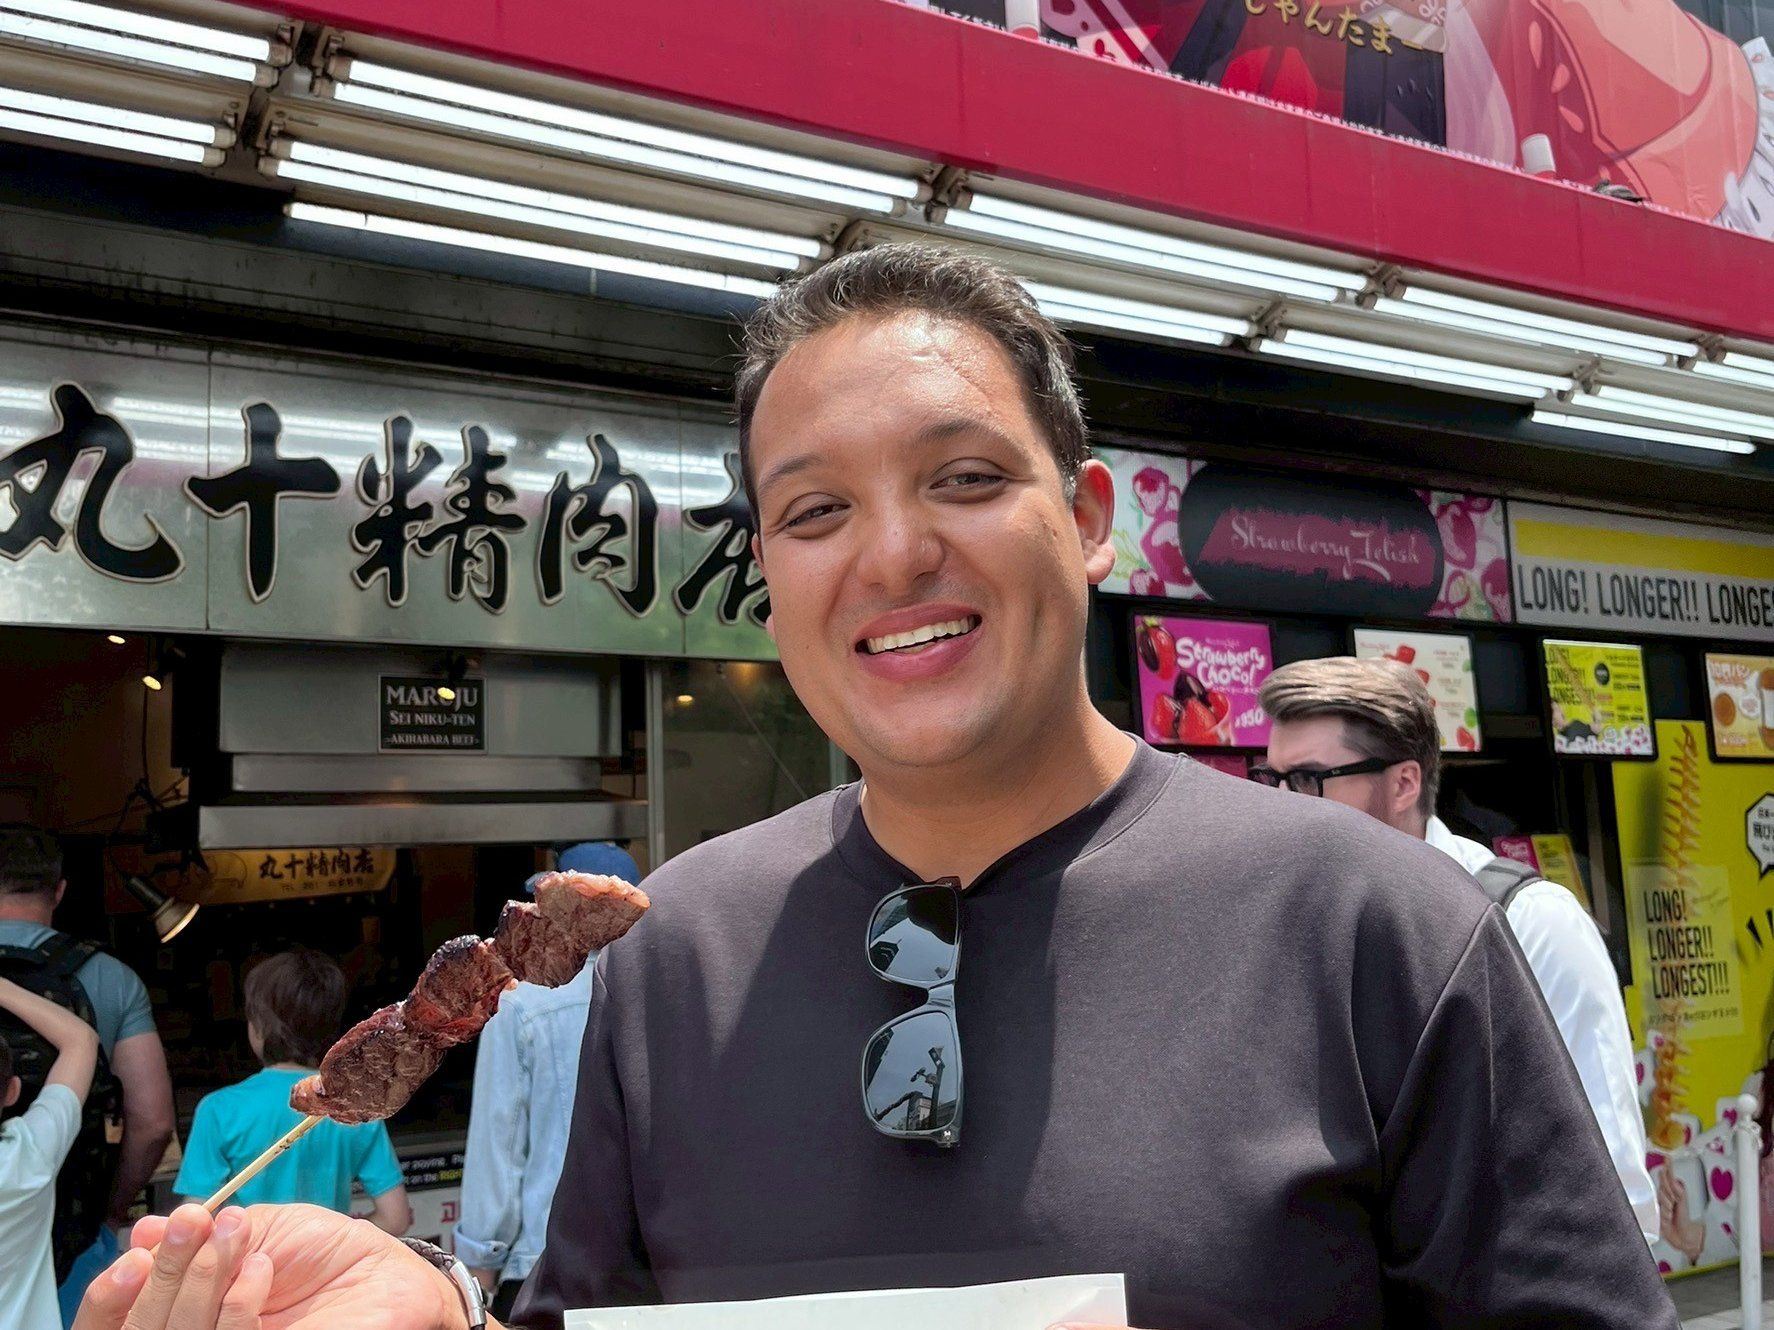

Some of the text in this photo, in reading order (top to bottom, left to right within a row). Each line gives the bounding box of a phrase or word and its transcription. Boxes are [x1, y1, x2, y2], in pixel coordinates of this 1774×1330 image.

[1231, 515, 1351, 581] Strawberry
[1517, 563, 1774, 628] LONG! LONGER!! LONGE
[1176, 637, 1265, 670] Strawberry
[1644, 889, 1688, 923] LONG!
[1648, 925, 1715, 962] LONGER!!
[1651, 961, 1730, 1000] LONGEST!!!
